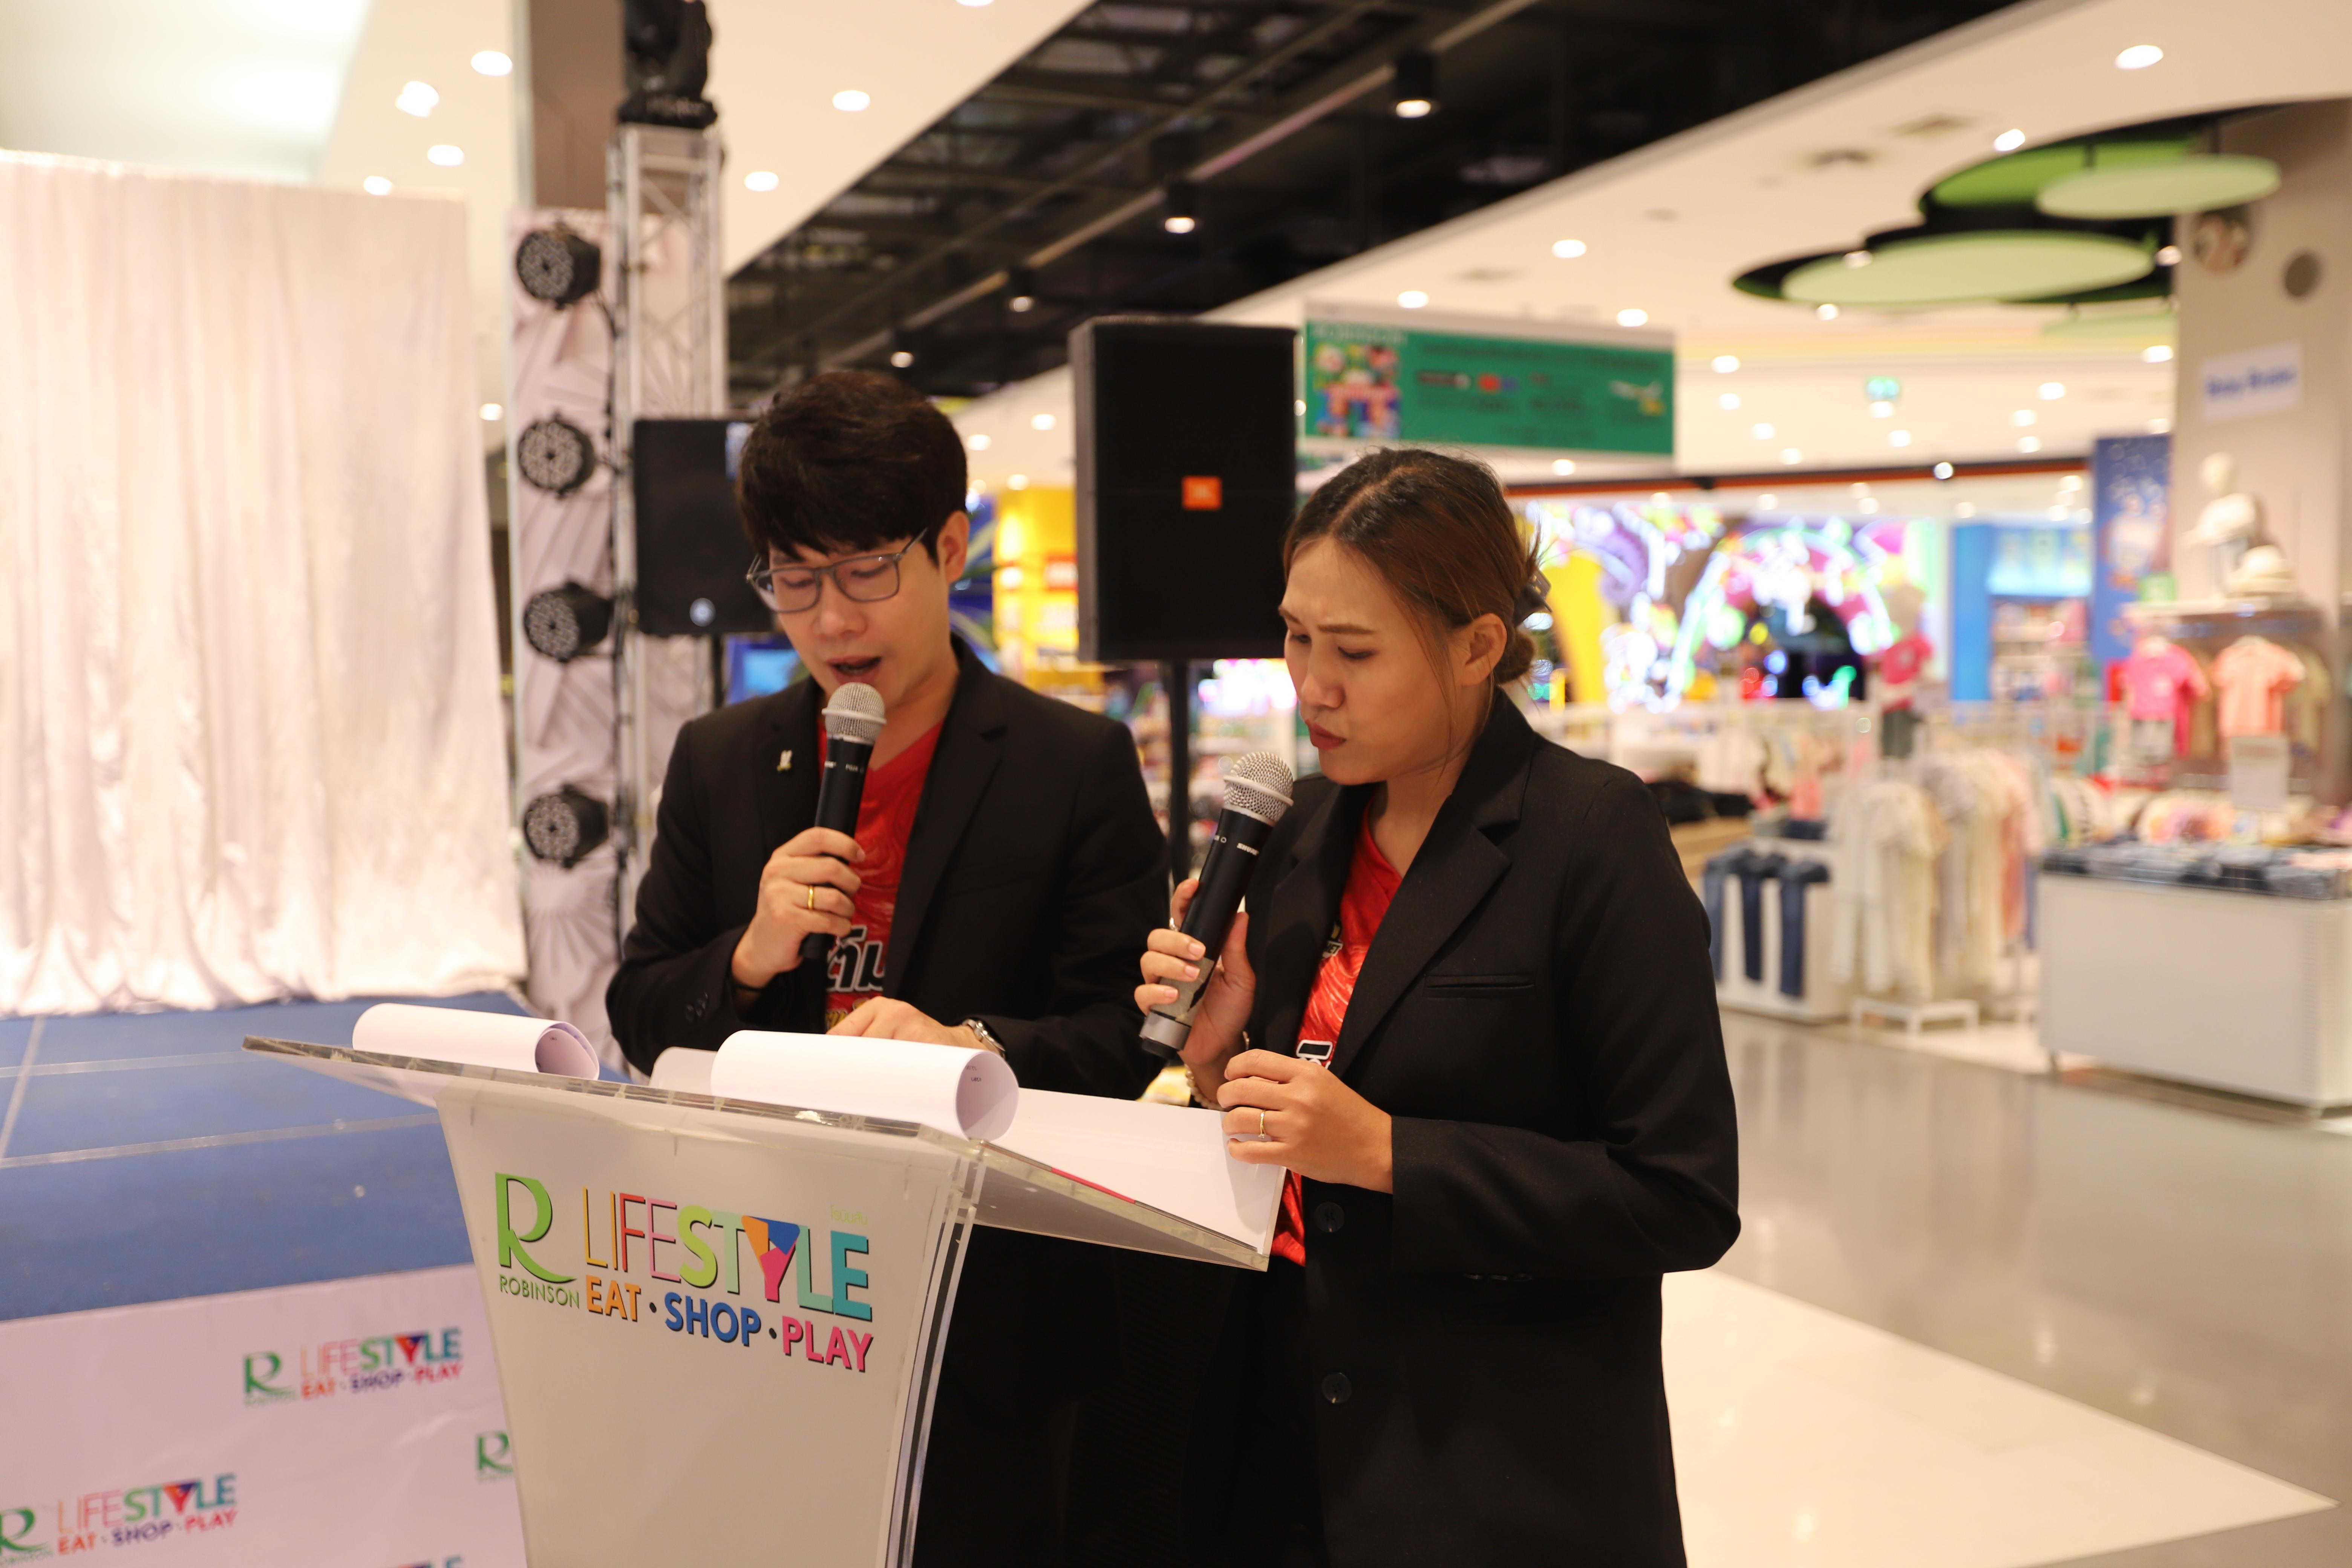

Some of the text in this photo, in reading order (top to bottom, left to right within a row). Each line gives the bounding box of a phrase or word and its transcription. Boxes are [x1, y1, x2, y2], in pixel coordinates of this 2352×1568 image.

[583, 1185, 872, 1322] LIFESTYLE
[499, 1273, 580, 1309] ROBINSON
[586, 1274, 874, 1373] EAT SHOP PLAY
[300, 1327, 462, 1380] LIFESTYLE
[302, 1362, 463, 1401] EAT SHOP PLAY
[57, 1472, 236, 1534] LIFESTYLE
[58, 1509, 238, 1555] EAT SHOP PLAY
